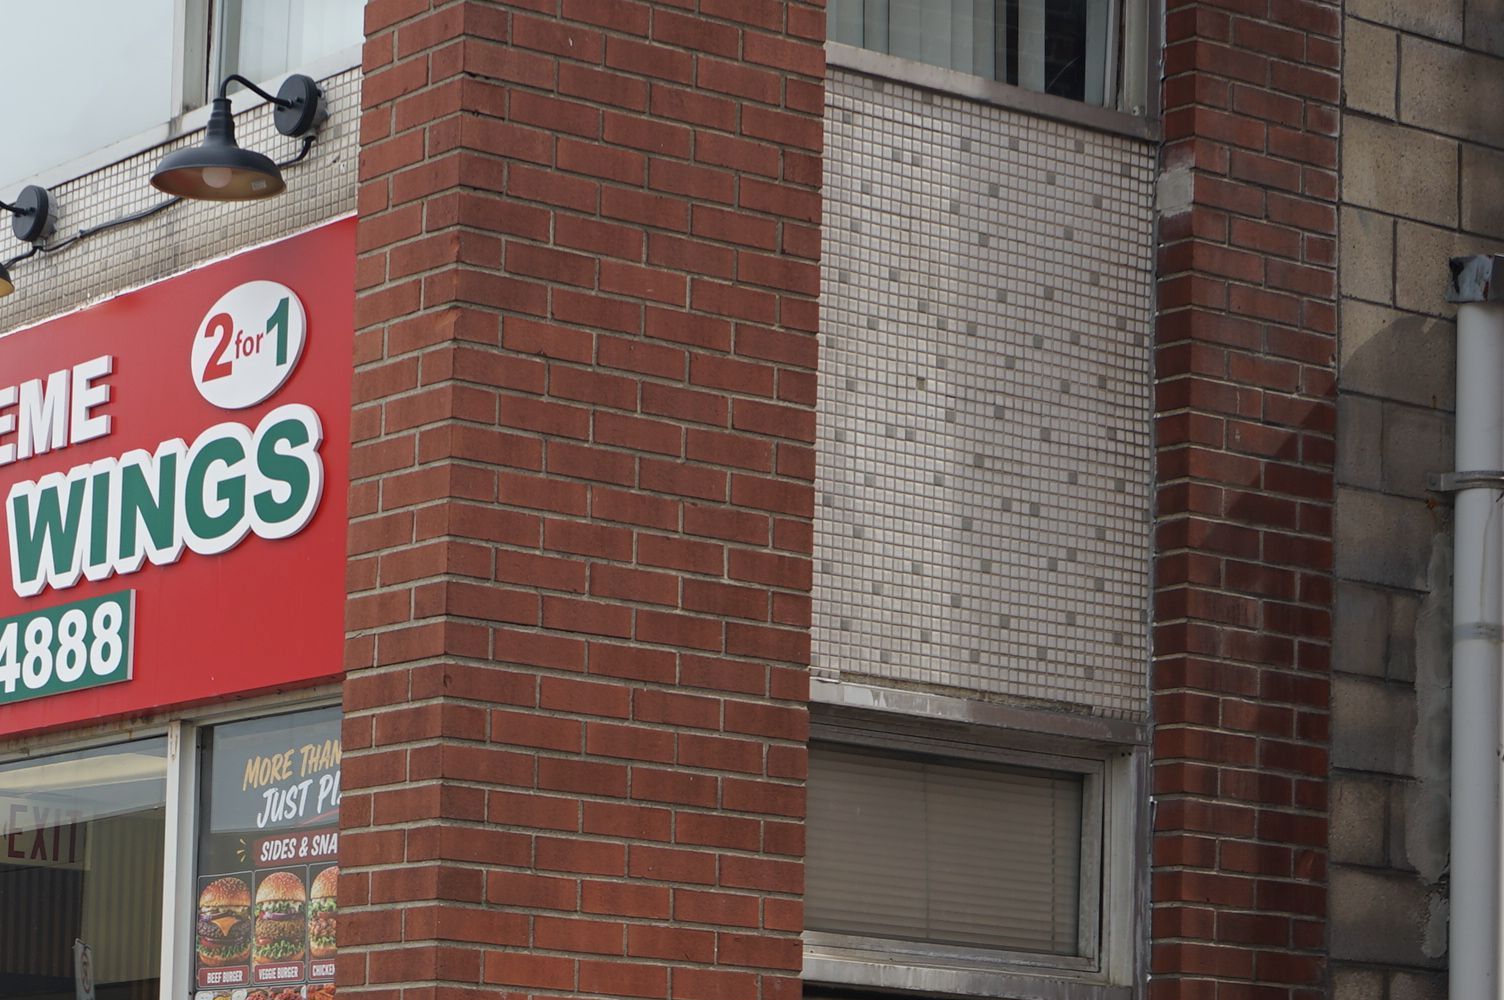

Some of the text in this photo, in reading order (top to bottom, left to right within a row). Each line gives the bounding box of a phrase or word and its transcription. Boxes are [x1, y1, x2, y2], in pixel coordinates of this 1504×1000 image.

[201, 296, 289, 383] 2 for 1
[7, 404, 323, 597] WINGS
[242, 749, 294, 791] MORE
[256, 779, 313, 829] JUST
[7, 804, 83, 864] EXIT
[260, 837, 297, 862] SIDES
[299, 836, 308, 857] &
[207, 972, 221, 984] BEEF
